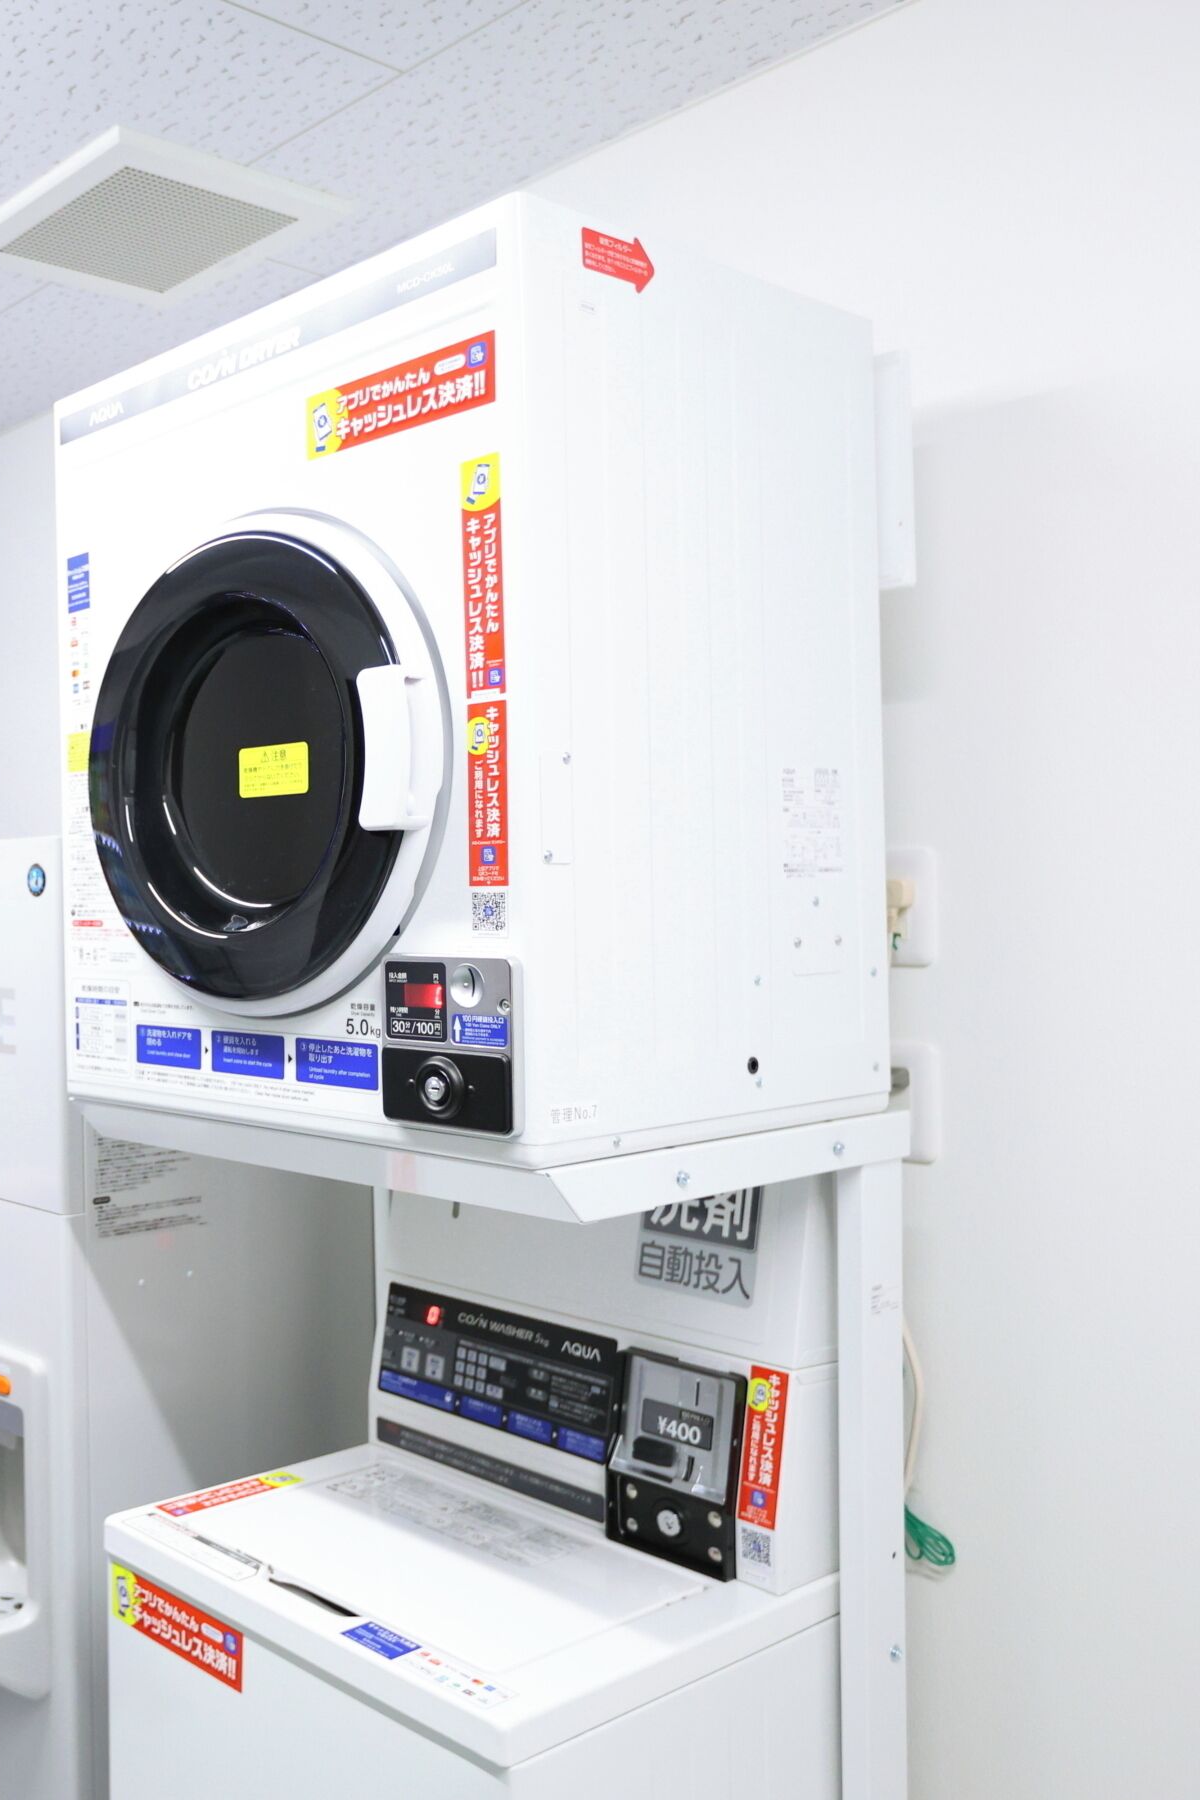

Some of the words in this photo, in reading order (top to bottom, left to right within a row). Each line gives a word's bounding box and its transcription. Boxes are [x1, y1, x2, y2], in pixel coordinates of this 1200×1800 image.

[238, 327, 300, 375] DRYER
[89, 401, 124, 427] AQUA
[337, 366, 430, 415] アプリでかんたん
[483, 512, 500, 634] アプリでかんたん
[485, 706, 502, 839] キャッシュレス決済
[474, 760, 484, 839] ご利用になれます
[308, 1043, 372, 1058] 停止したあと洗濯物を
[346, 1017, 369, 1036] 5.0
[370, 1025, 381, 1038] kg
[638, 1240, 750, 1300] 自動投入
[489, 1320, 533, 1341] WASHER
[561, 1340, 601, 1362] AQUA
[657, 1415, 701, 1444] ¥400
[758, 1373, 781, 1488] キャッシュレス決済
[135, 1583, 199, 1634] アプリでかんたん
